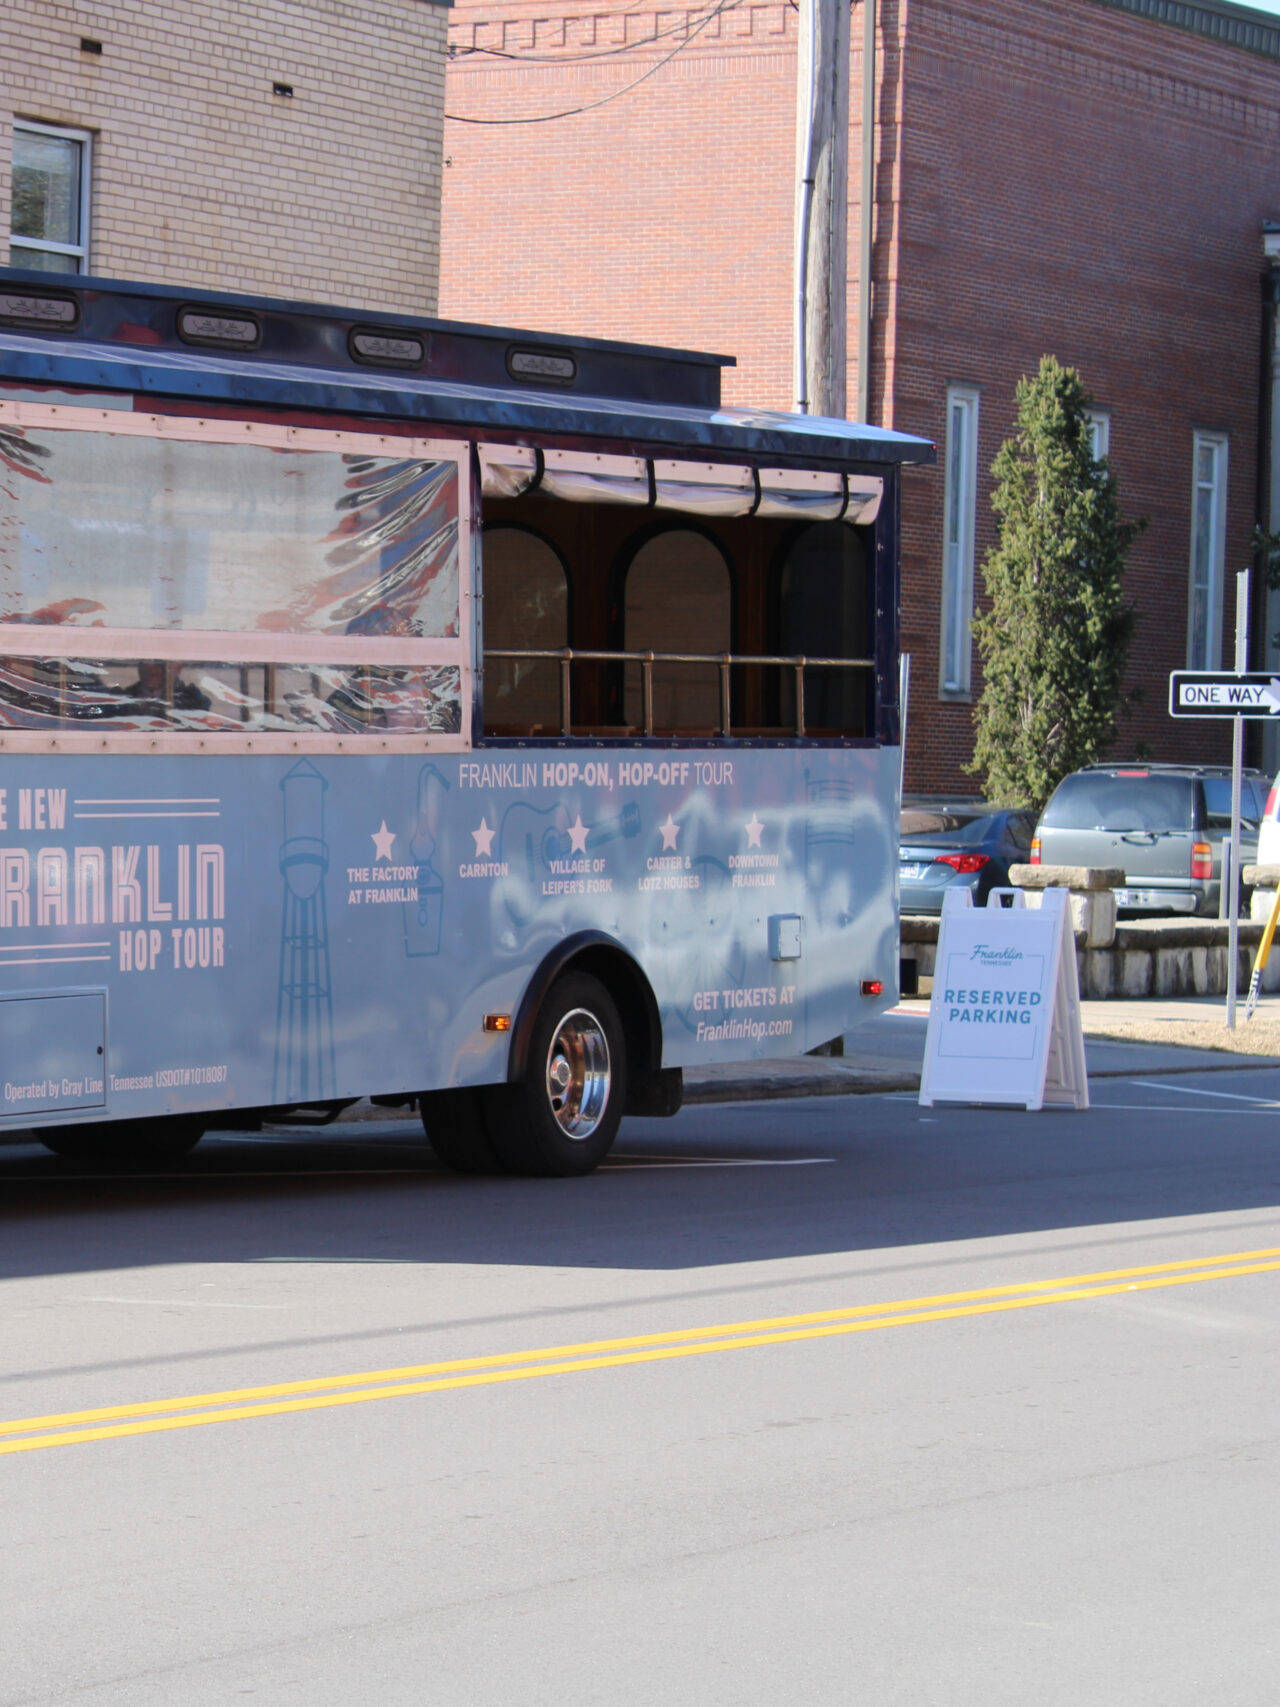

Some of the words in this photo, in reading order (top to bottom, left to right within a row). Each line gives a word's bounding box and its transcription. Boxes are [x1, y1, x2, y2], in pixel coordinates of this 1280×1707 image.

[1184, 686, 1221, 703] ONE
[1228, 687, 1265, 703] WAY
[459, 763, 537, 788] FRANKLIN
[542, 762, 614, 791] HOP-ON,
[619, 762, 689, 786] HOP-OFF
[694, 762, 734, 785] TOUR
[18, 788, 66, 830] NEW
[459, 862, 509, 878] CARNTON
[549, 859, 591, 874] VILLAGE
[593, 858, 606, 872] OF
[646, 856, 683, 870] CARTER
[685, 856, 692, 869] &
[729, 855, 780, 869] DOWNTOWN
[347, 868, 369, 882] THE
[372, 866, 420, 882] FACTORY
[732, 874, 776, 888] FRANKLIN
[542, 879, 586, 895] LEIPER'S
[587, 879, 613, 893] FORK
[638, 876, 662, 891] LOTZ
[664, 875, 700, 889] HOUSES
[348, 890, 363, 904] AT
[366, 887, 418, 903] FRANKLIN
[120, 929, 162, 971] HOP
[172, 927, 224, 969] TOUR
[969, 944, 1023, 961] Franklin
[693, 990, 720, 1011] GET
[722, 987, 777, 1009] TICKETS
[779, 985, 796, 1005] AT
[944, 989, 1041, 1006] RESERVED
[949, 1008, 1032, 1025] PARKING
[696, 1017, 793, 1042] FranklinHop.com
[5, 1080, 46, 1103] Operated
[49, 1079, 60, 1098] by
[62, 1078, 83, 1096] Gray
[85, 1076, 103, 1094] Line
[109, 1074, 153, 1091] Tennessee
